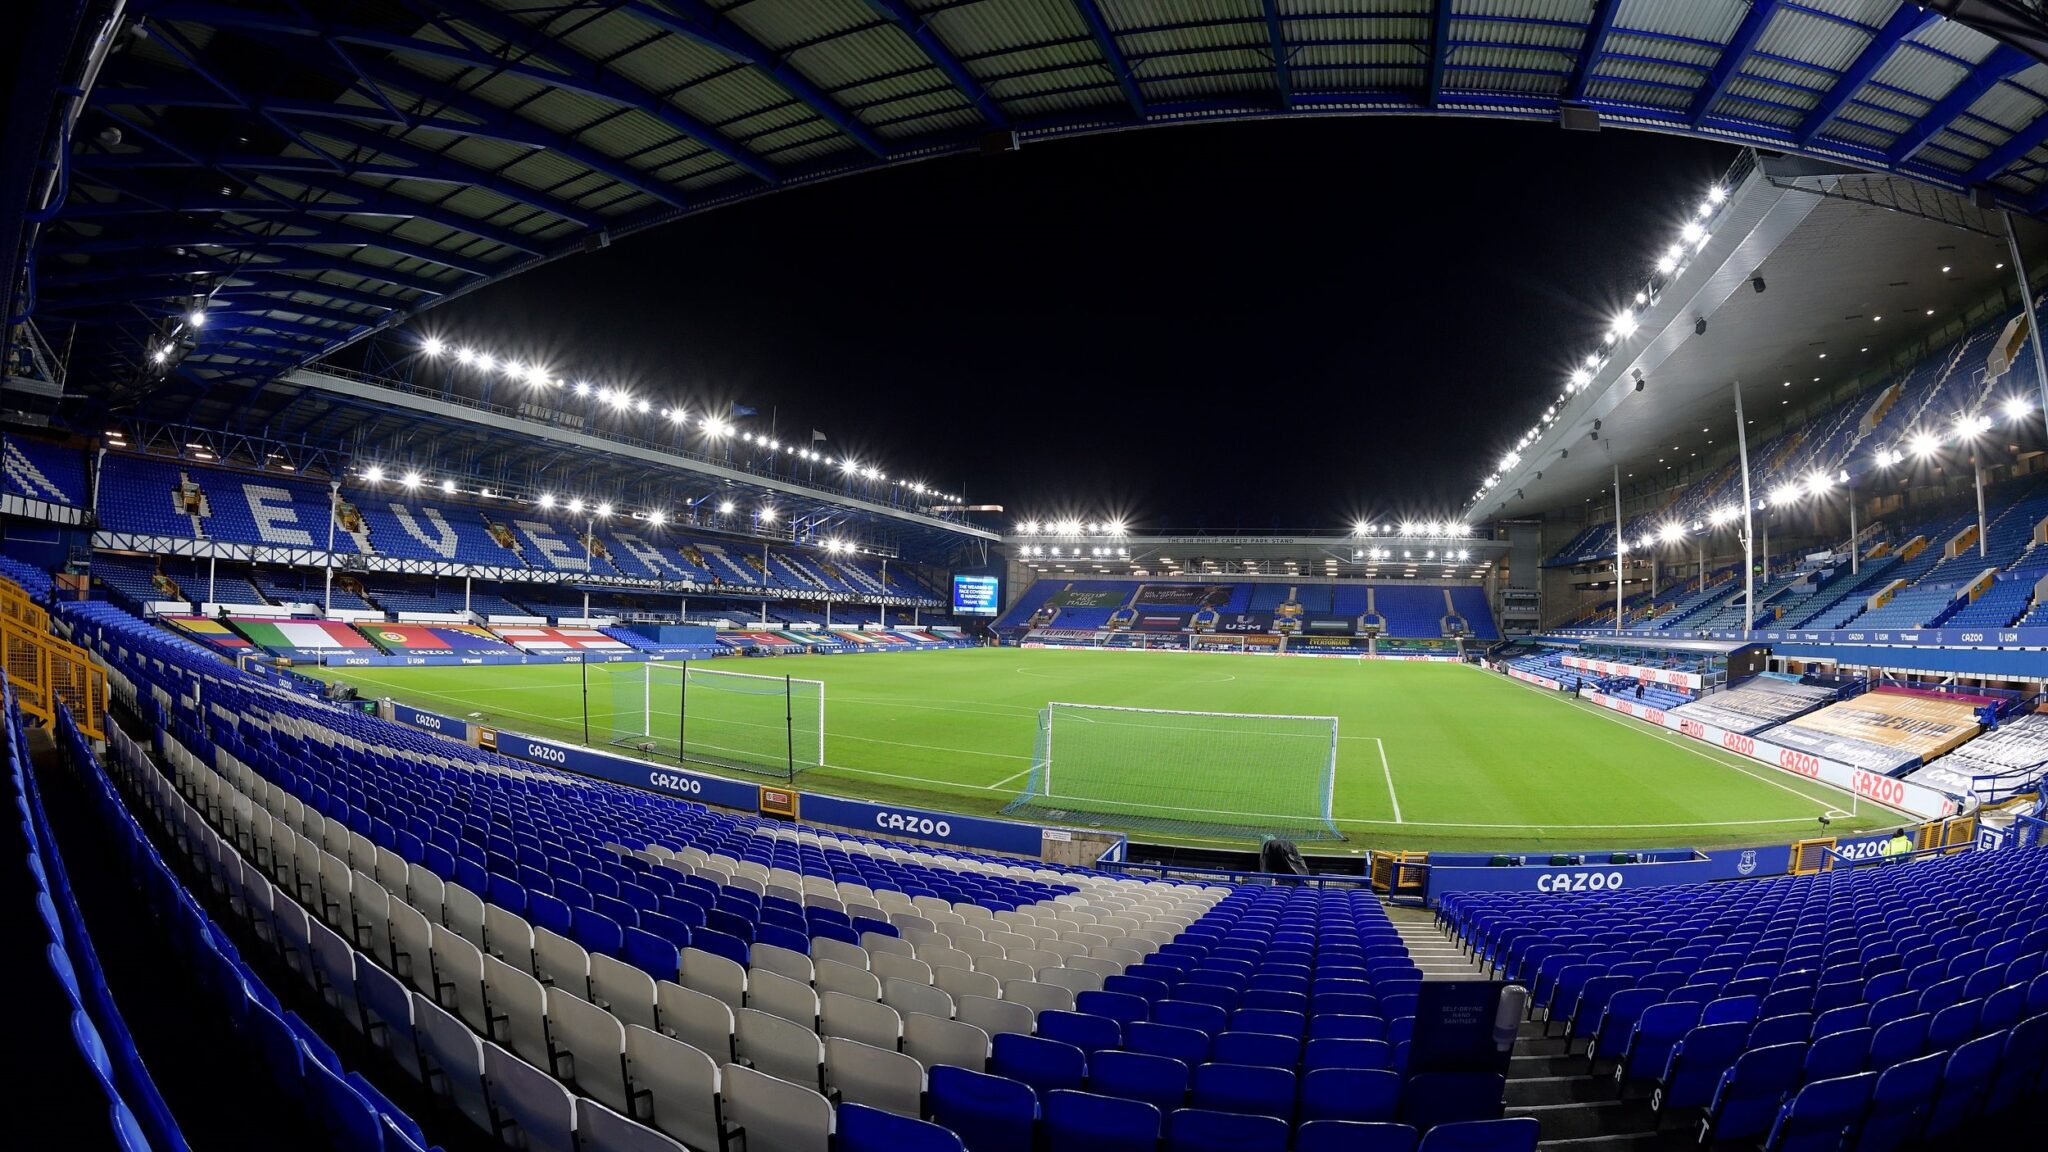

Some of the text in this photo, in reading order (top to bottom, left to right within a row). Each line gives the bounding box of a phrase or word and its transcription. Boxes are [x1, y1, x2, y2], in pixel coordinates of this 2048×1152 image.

[1961, 633, 2018, 642] CAZOO USM
[278, 678, 293, 690] CAZOO
[1639, 668, 1657, 681] CAZOO
[1668, 672, 1688, 686] CAZOO
[1616, 699, 1633, 715] CAZOO
[1645, 707, 1665, 726] CAZOO
[415, 713, 441, 730] CAZOO
[1680, 718, 1705, 740] CAZOO
[528, 743, 566, 764] CAZOO
[1723, 730, 1755, 757] CAZOO
[1779, 748, 1820, 780] CAZOO
[650, 771, 701, 794] CAZOO
[876, 811, 951, 837] CAZOO
[1537, 872, 1623, 892] CAZOO
[1564, 1023, 1572, 1036] P
[1587, 1040, 1595, 1061] Q
[1615, 1064, 1623, 1081] R
[1651, 1088, 1662, 1111] S
[1698, 1118, 1709, 1144] T
